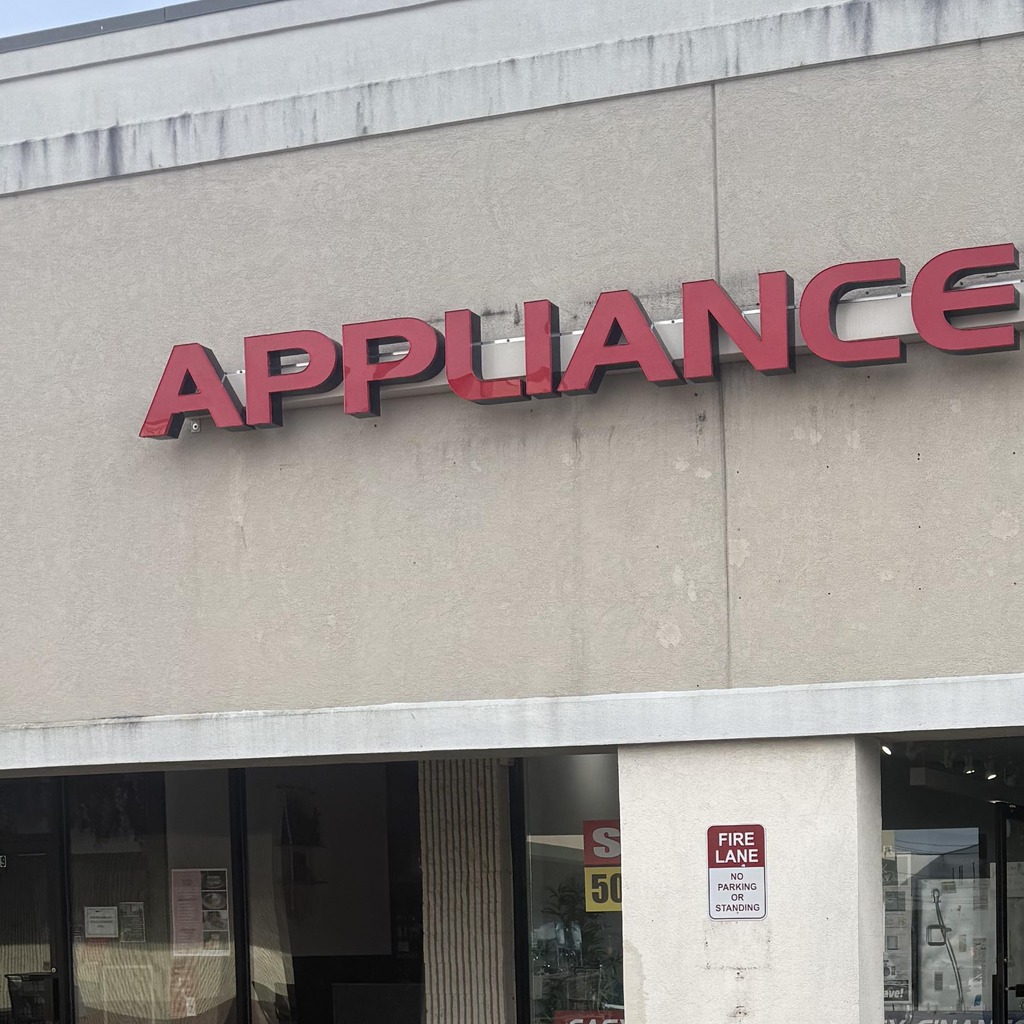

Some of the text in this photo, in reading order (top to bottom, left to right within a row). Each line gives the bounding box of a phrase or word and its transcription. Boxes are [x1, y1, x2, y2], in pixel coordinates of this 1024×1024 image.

[718, 832, 755, 847] FIRE
[715, 849, 759, 863] LANE
[717, 883, 757, 891] PARKING
[731, 893, 744, 901] OR
[715, 904, 760, 912] STANDING
